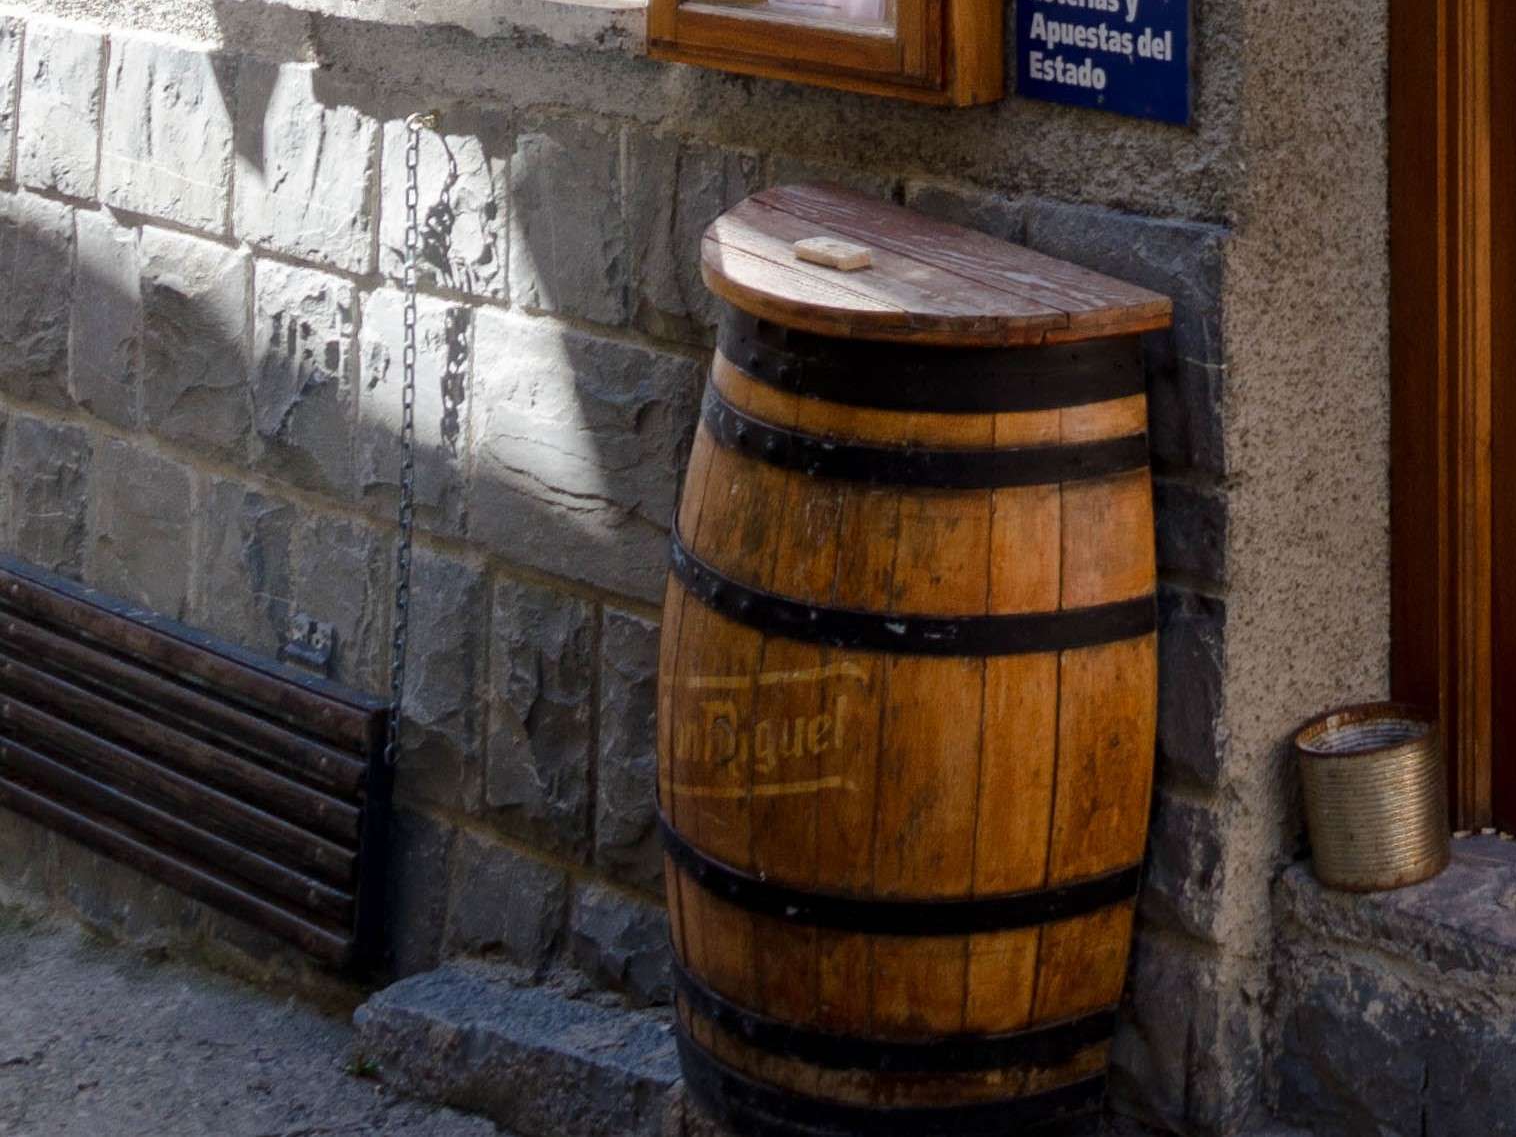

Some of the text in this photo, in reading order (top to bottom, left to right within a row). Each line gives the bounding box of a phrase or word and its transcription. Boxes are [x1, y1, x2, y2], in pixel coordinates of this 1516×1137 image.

[1029, 12, 1173, 61] Apuestas del
[1028, 50, 1106, 90] Estado
